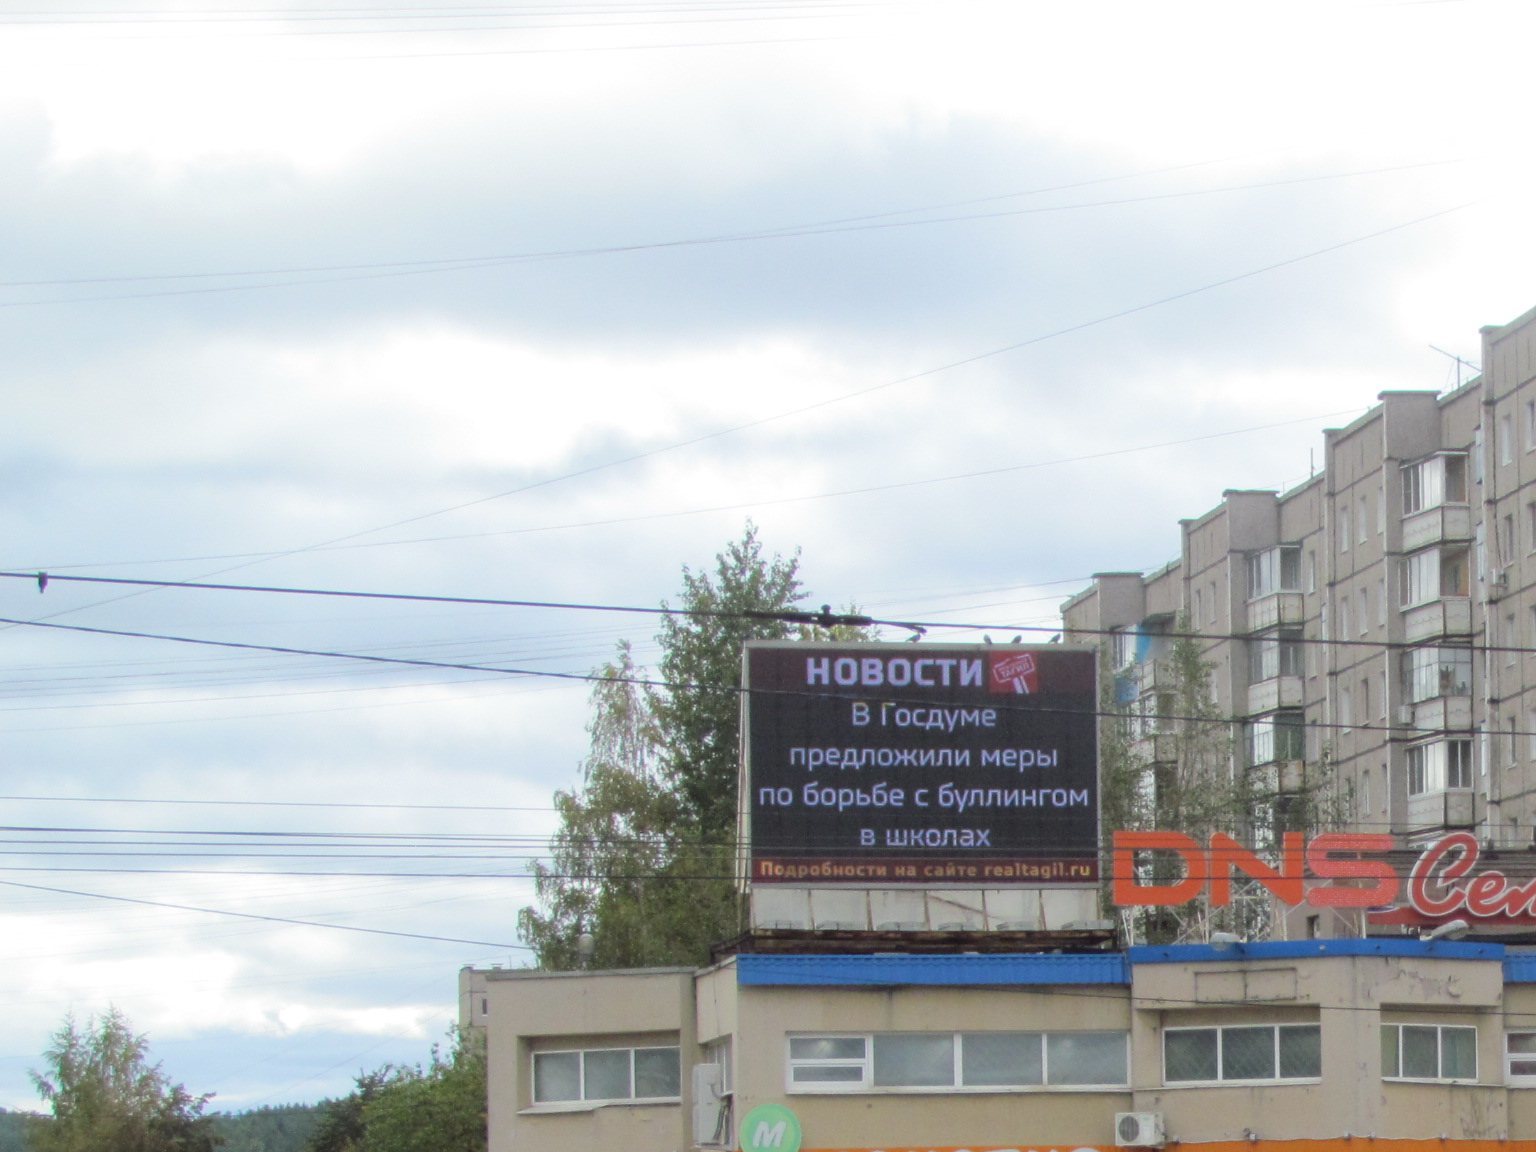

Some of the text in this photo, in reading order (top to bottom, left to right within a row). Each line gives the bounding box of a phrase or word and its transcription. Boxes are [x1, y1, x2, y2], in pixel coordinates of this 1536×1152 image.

[805, 657, 984, 687] НОВОСТИ
[852, 702, 997, 731] В Госдуме
[789, 748, 1058, 773] предложили меры
[759, 781, 1089, 812] по борьбе с буллингом
[860, 828, 991, 847] в школах
[760, 860, 1092, 881] Подробности на сайте realtagil.ru
[1113, 831, 1400, 907] DNS
